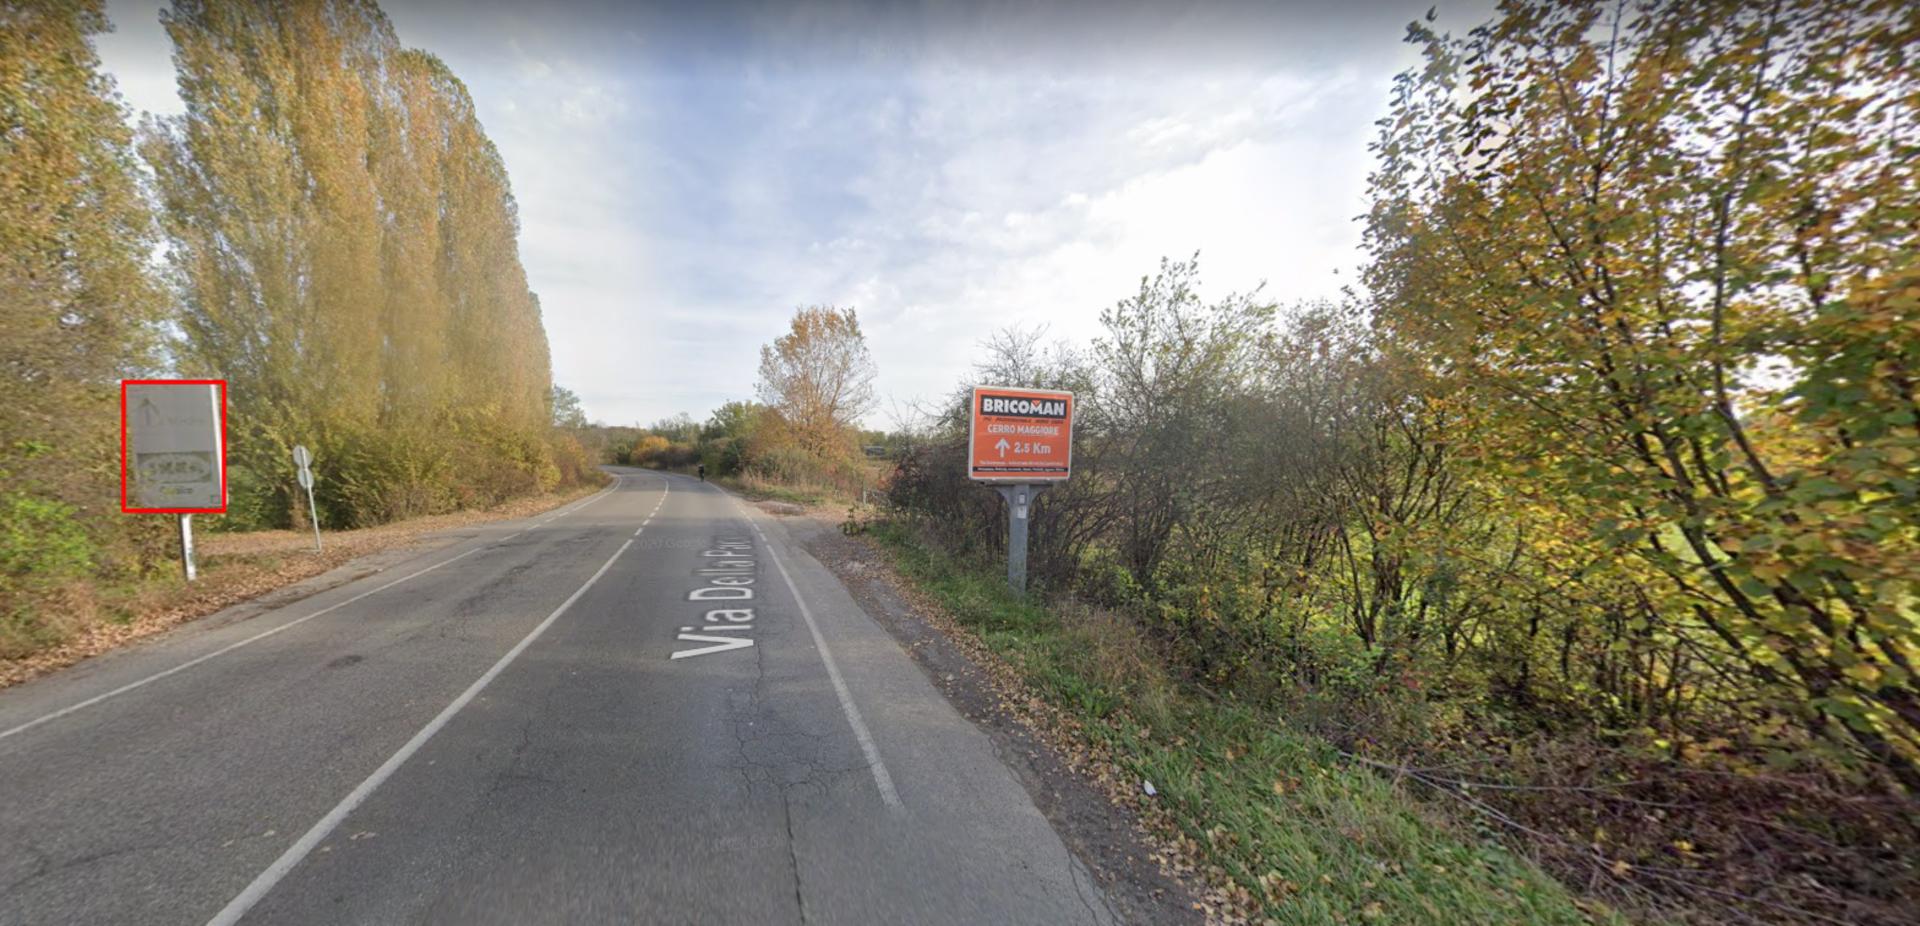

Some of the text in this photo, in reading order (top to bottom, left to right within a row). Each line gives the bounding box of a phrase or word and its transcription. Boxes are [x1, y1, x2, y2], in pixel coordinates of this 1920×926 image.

[983, 398, 1065, 416] BRICOMAN
[987, 424, 1060, 436] CERRO MAGGIORE
[1033, 442, 1051, 455] Km
